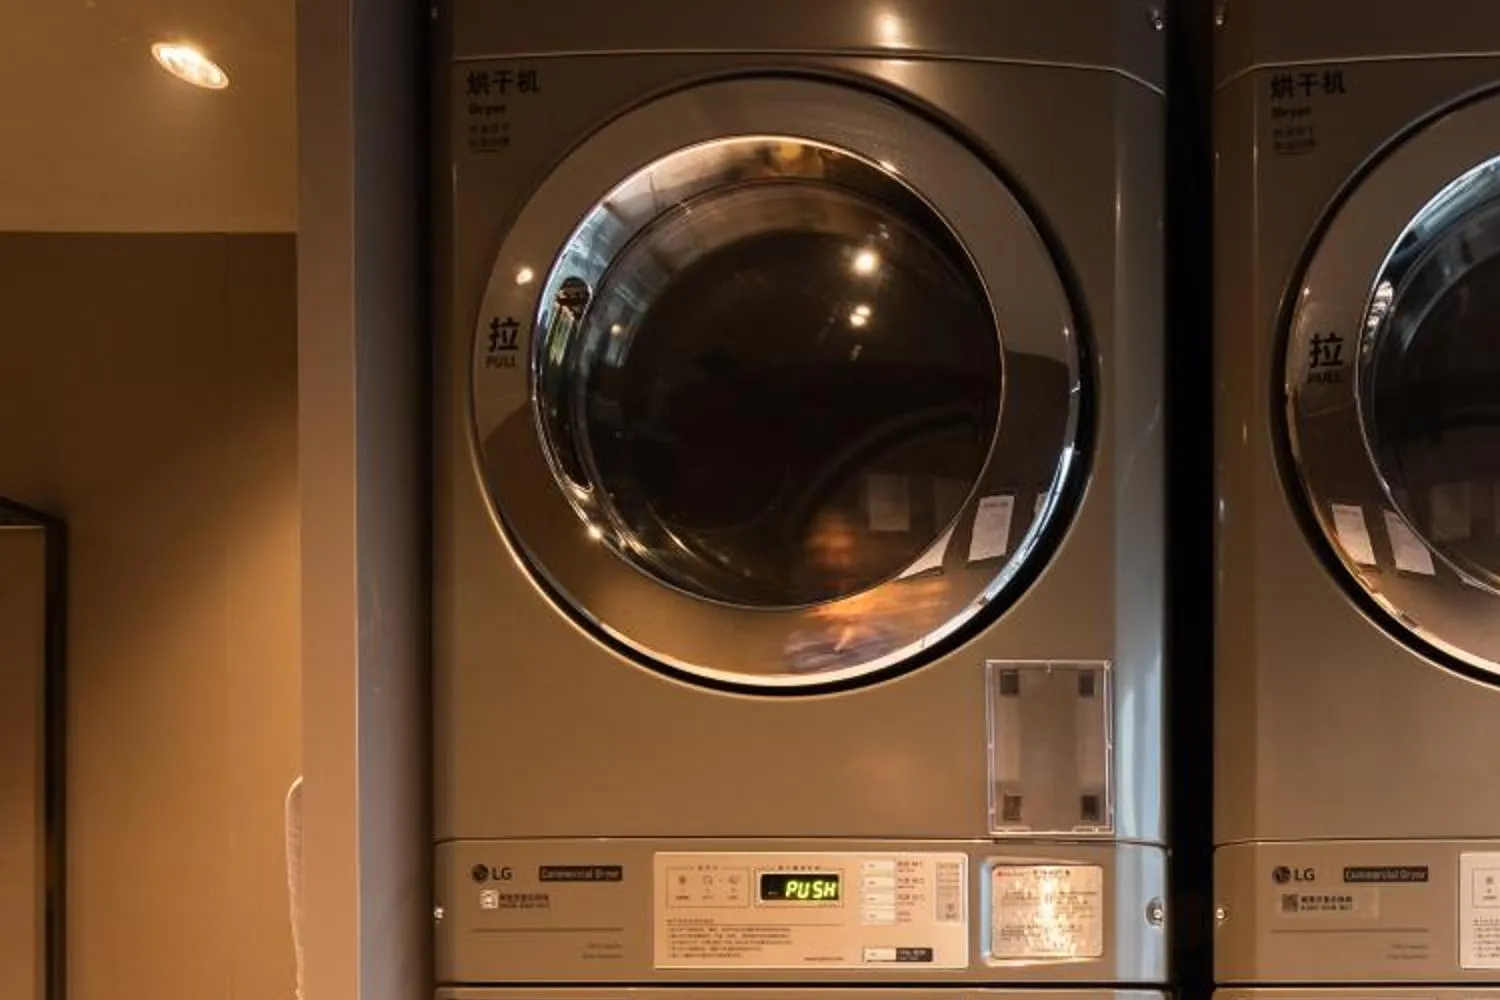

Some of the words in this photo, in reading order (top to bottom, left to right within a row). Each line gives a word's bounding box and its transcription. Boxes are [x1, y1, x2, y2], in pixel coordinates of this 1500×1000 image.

[467, 70, 541, 95] 烘干机
[1271, 69, 1347, 98] 烘干机
[489, 317, 520, 353] 拉
[486, 355, 516, 368] PULL
[1310, 332, 1343, 368] 拉
[785, 880, 838, 898] PUSH
